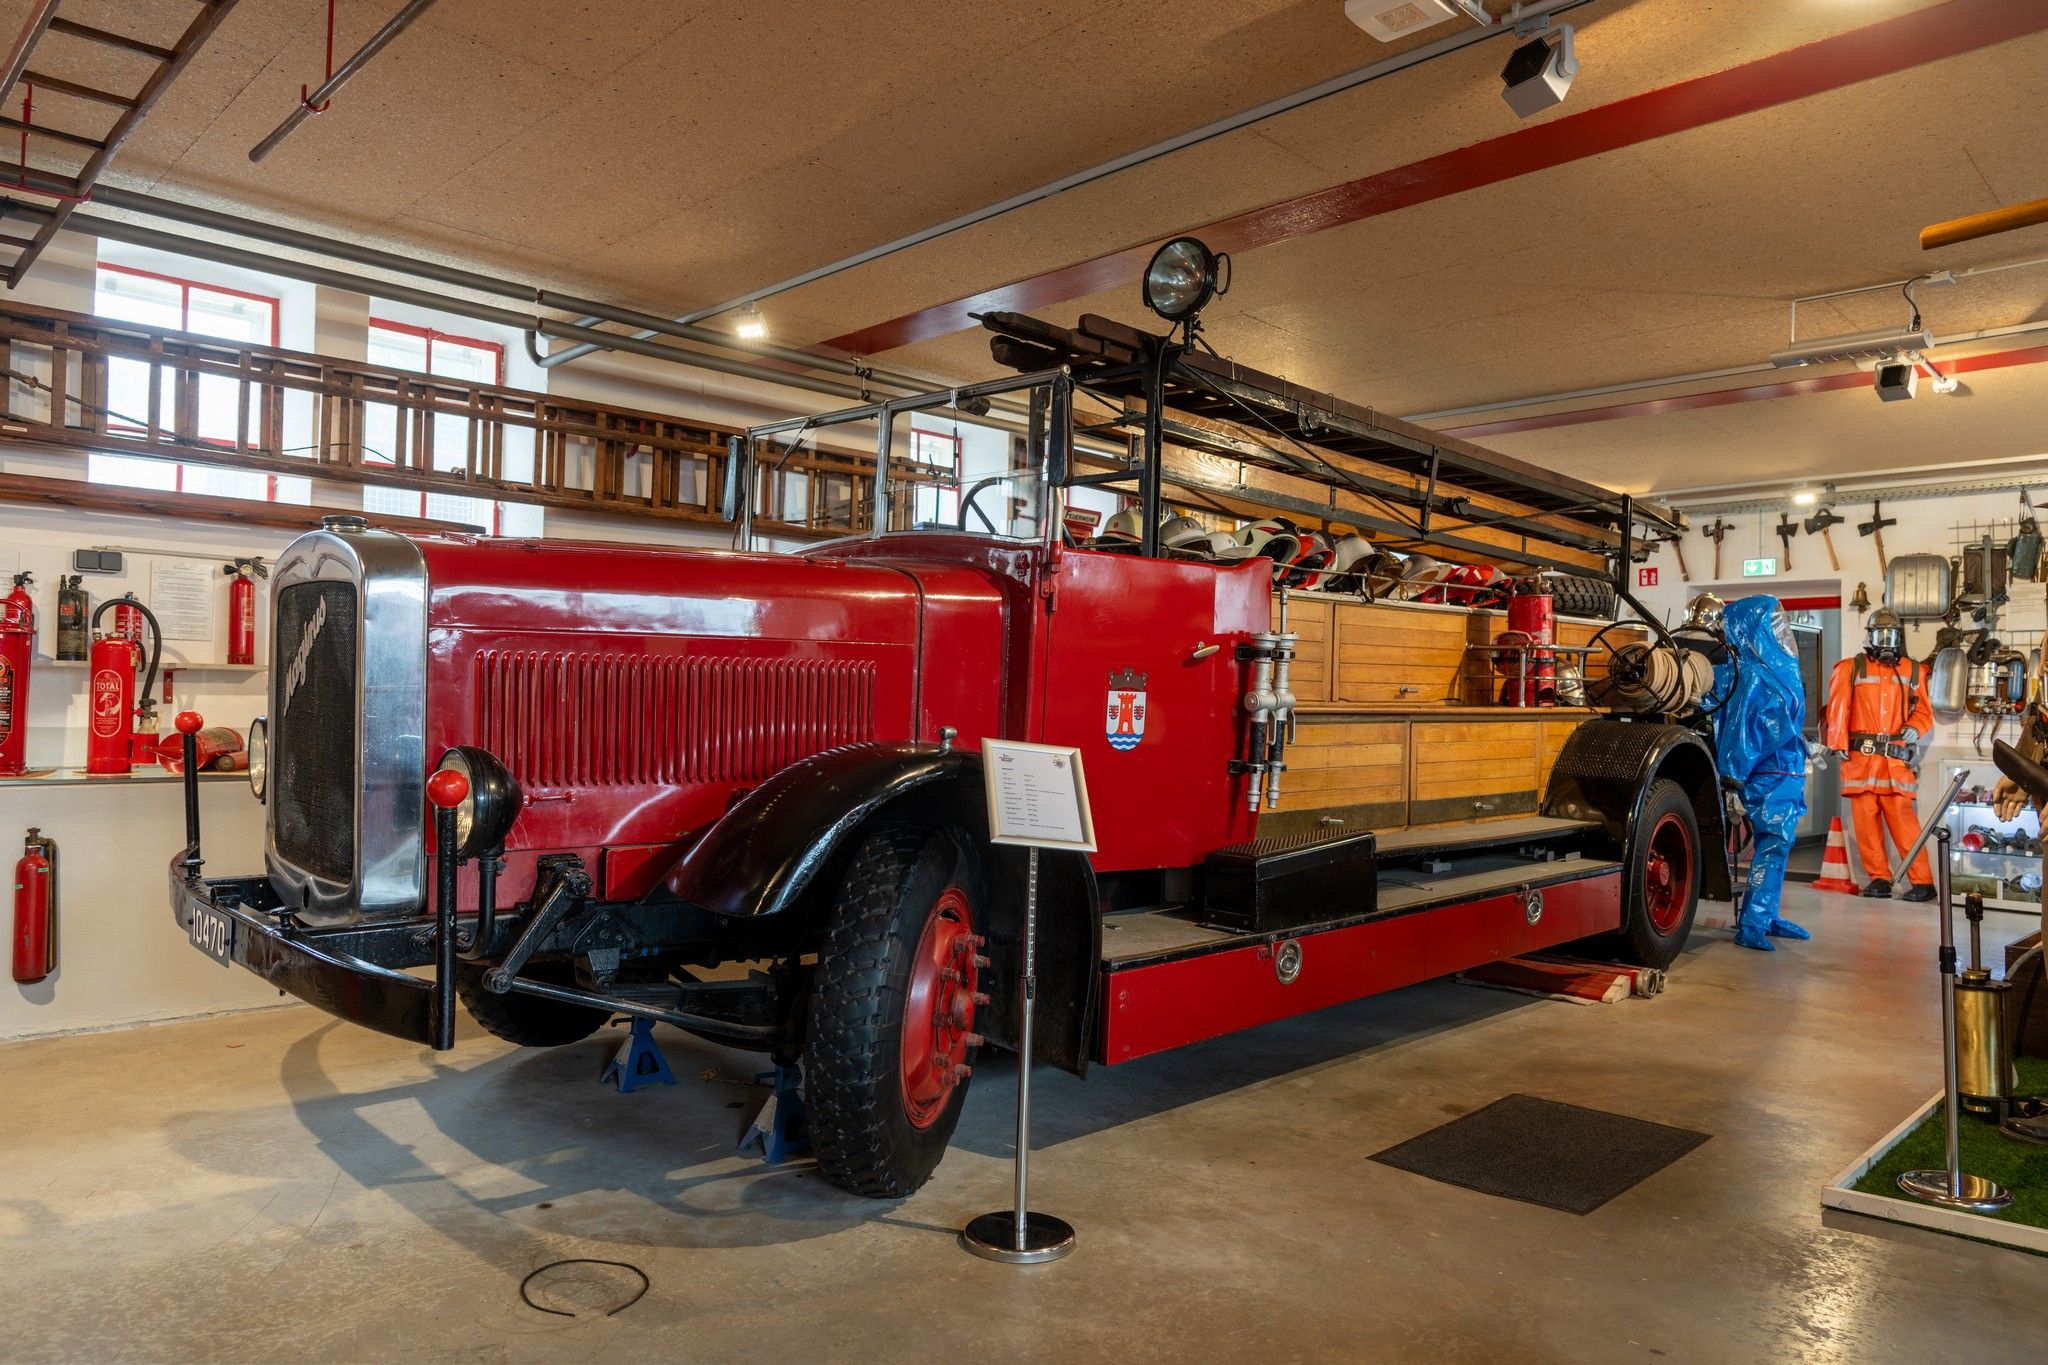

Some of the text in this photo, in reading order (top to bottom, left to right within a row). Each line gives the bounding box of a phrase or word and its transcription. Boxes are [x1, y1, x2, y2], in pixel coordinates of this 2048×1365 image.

[284, 595, 326, 717] Magirus
[96, 682, 120, 690] TOTAL
[193, 907, 225, 957] 10470
